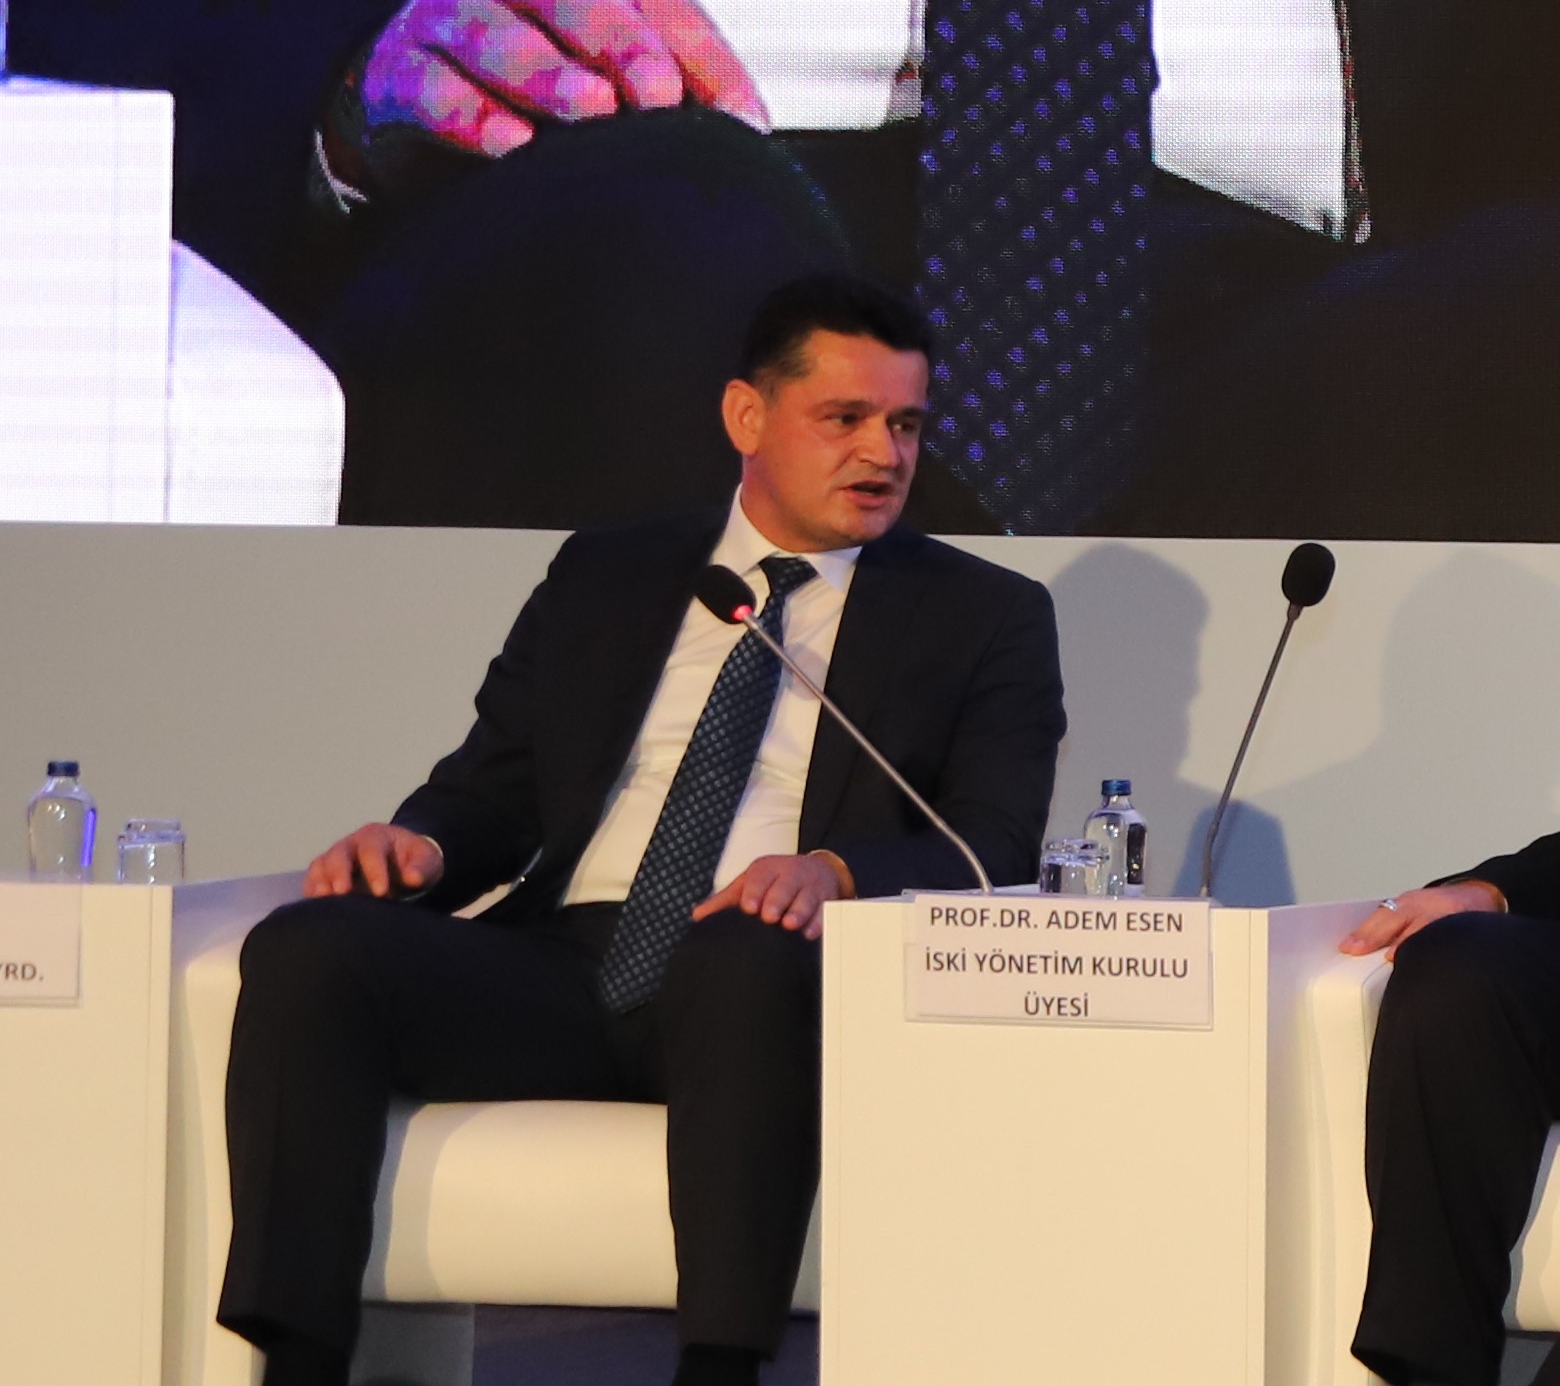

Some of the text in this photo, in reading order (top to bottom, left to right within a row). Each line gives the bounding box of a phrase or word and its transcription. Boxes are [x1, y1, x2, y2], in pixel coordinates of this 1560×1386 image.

[930, 907, 1183, 933] PROF.DR. ADEM ESEN
[0, 963, 45, 982] RD.
[925, 946, 1188, 978] İSKİ YÖNETİM KURULU
[1024, 991, 1089, 1017] ÜYESİ
